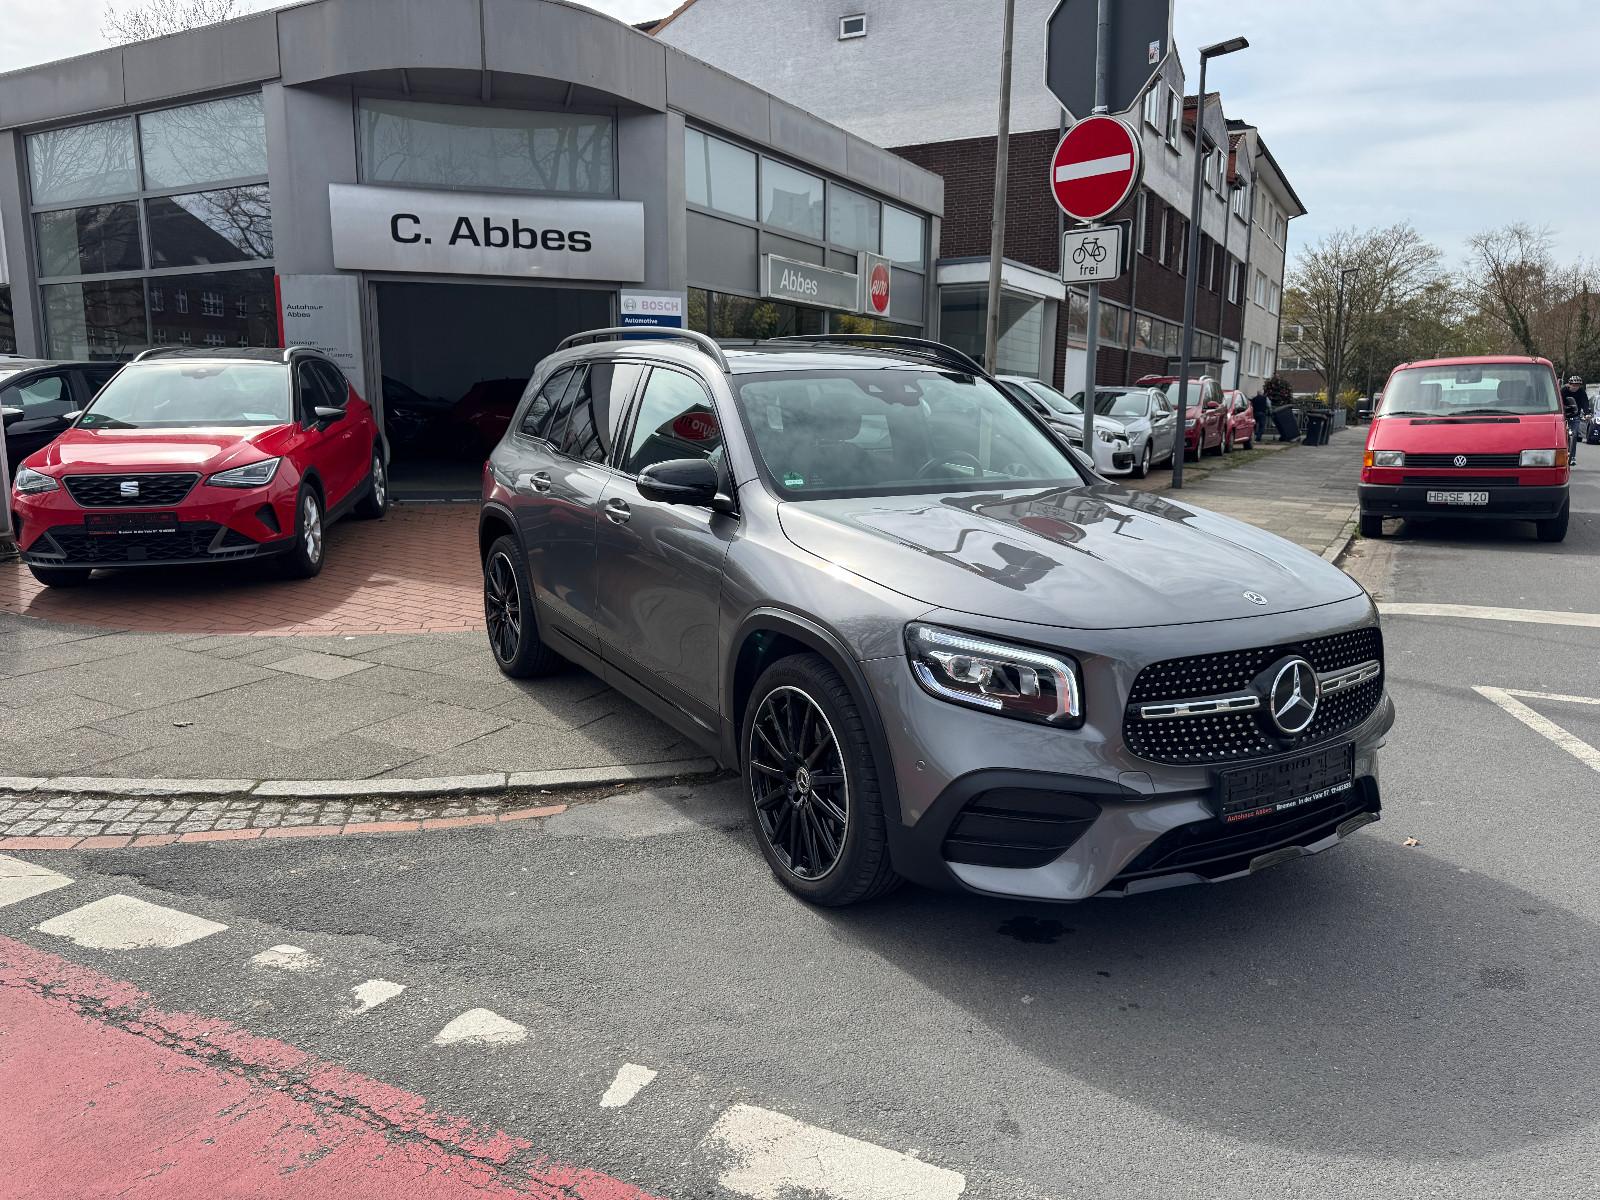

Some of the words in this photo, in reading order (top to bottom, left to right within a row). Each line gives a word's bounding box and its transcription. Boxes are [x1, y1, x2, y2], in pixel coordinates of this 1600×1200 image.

[390, 213, 432, 244] C.
[448, 216, 592, 252] Abbes
[1080, 263, 1099, 275] frei
[780, 268, 818, 295] Abbes
[870, 279, 888, 296] AUTO
[641, 300, 679, 312] BOSCH
[624, 317, 658, 325] Automotive
[1469, 493, 1487, 502] 120
[1276, 800, 1297, 811] Bremen
